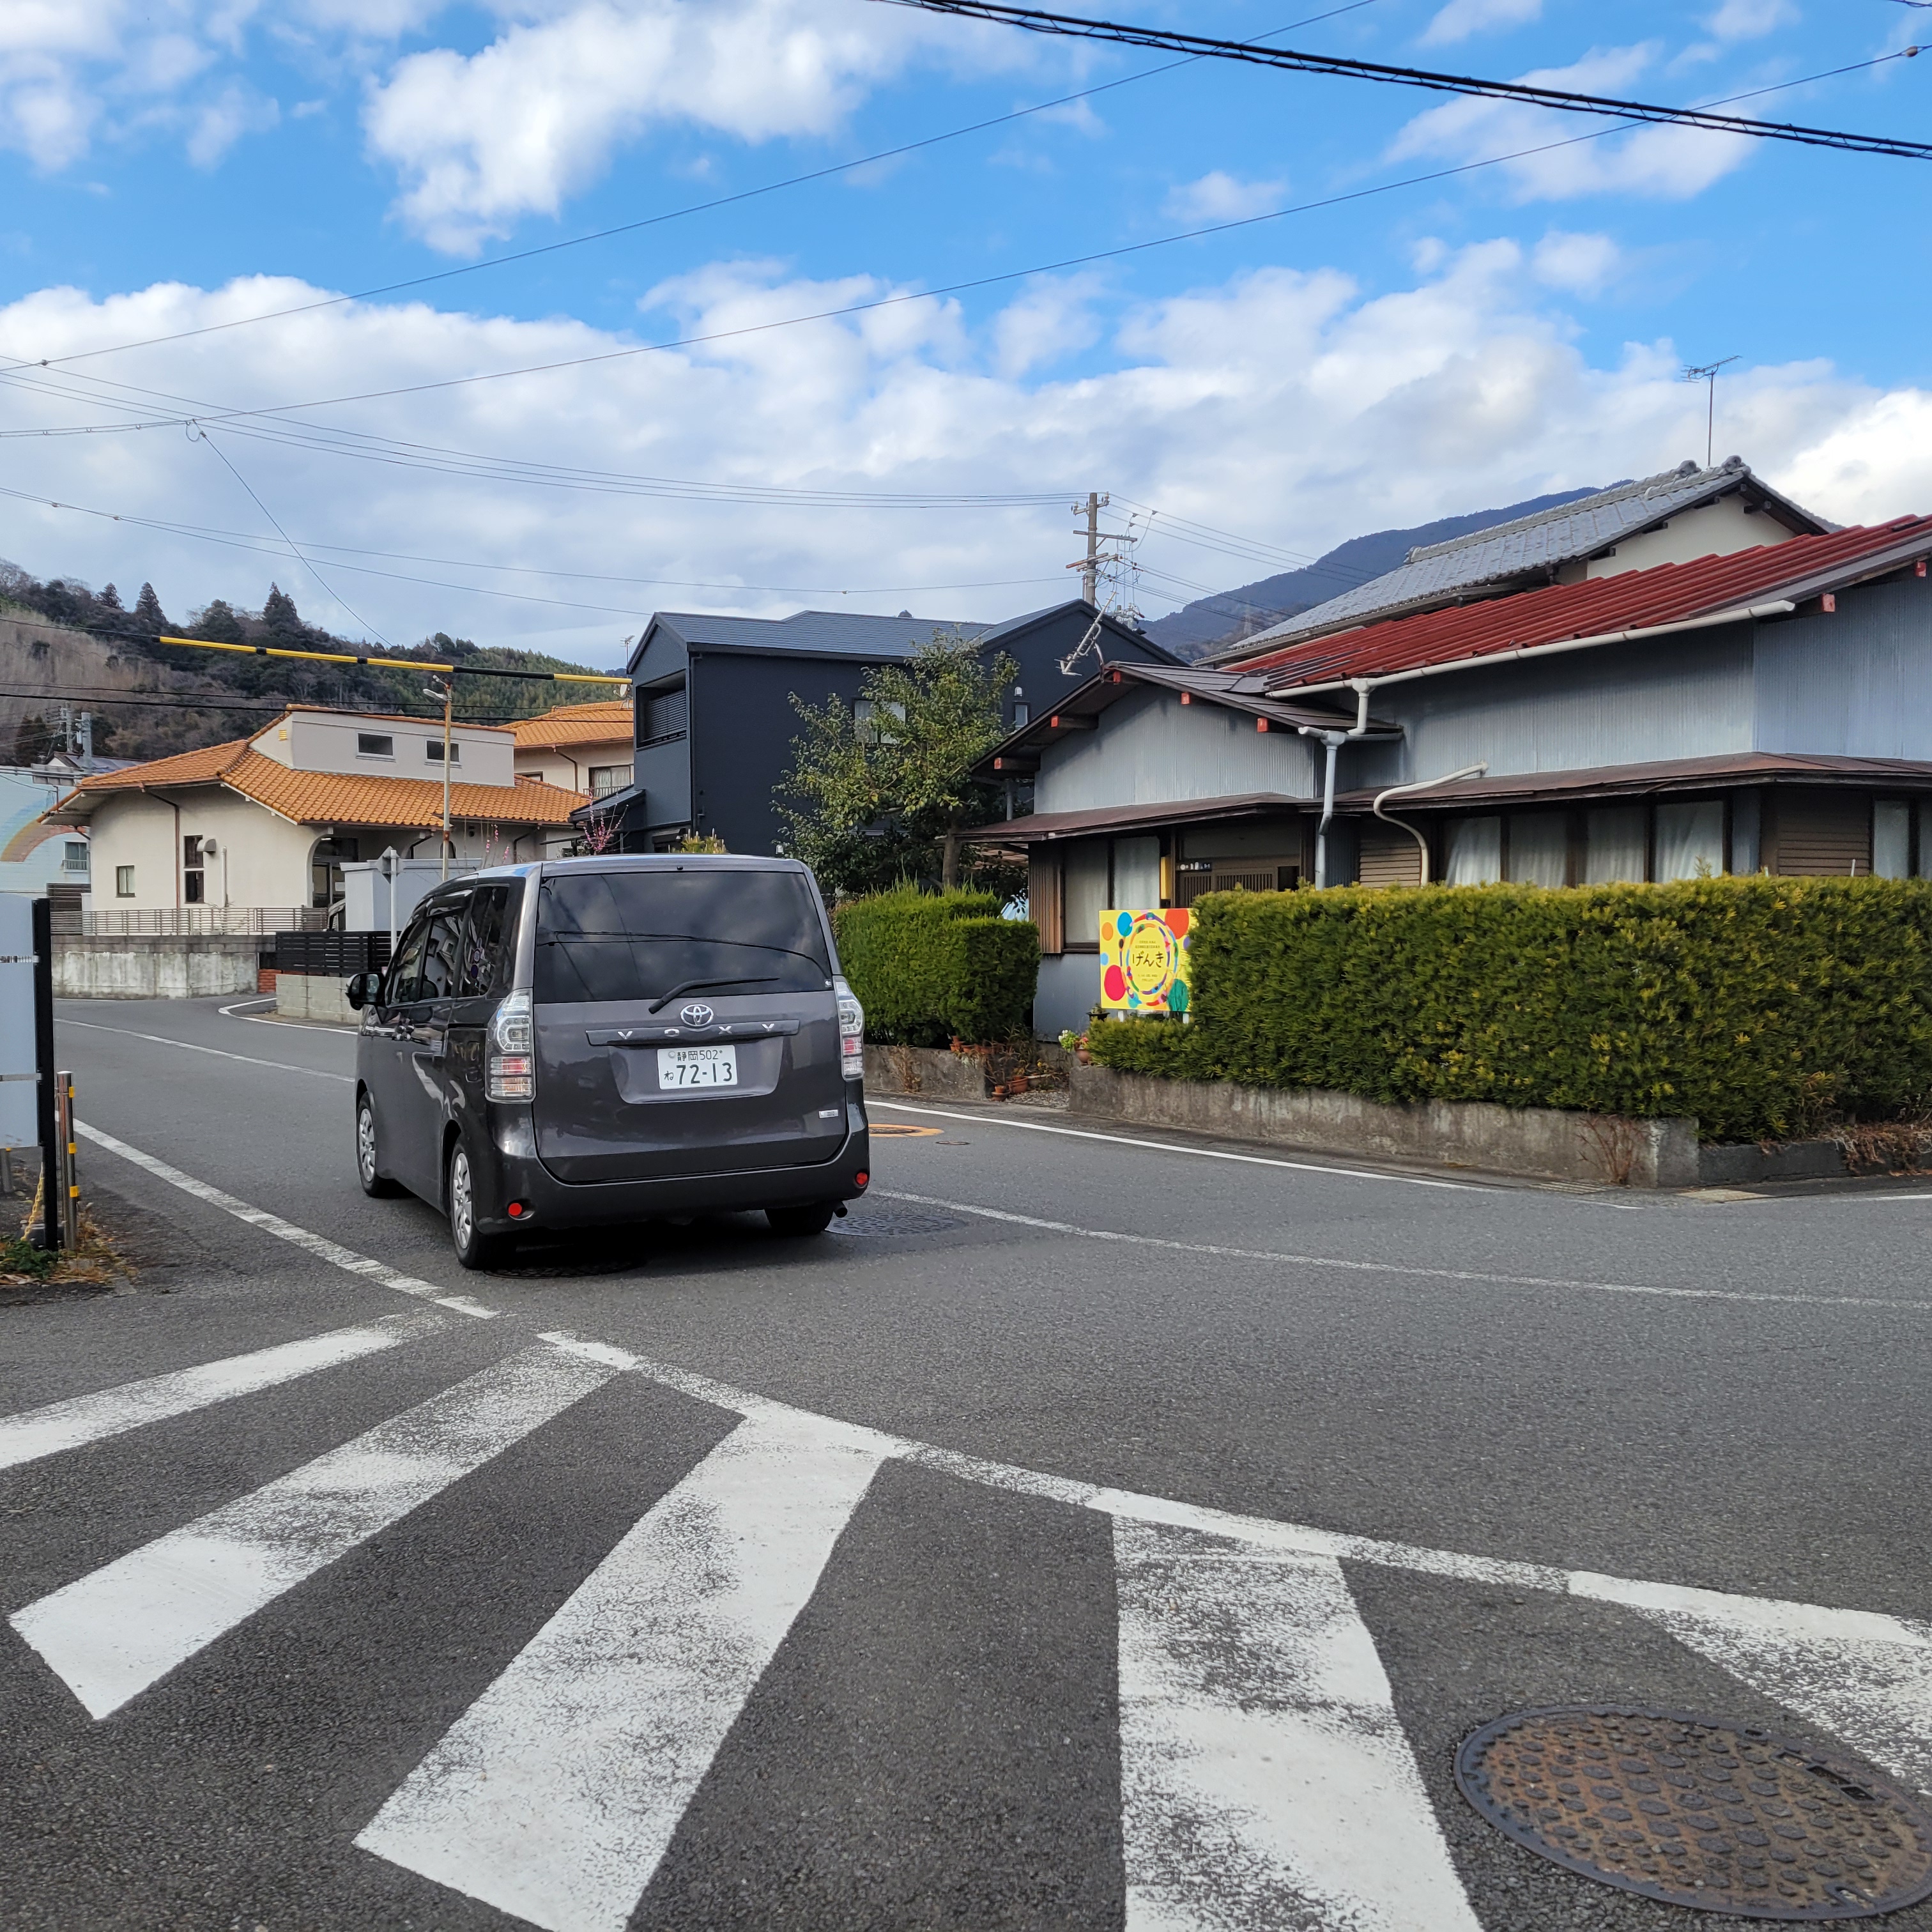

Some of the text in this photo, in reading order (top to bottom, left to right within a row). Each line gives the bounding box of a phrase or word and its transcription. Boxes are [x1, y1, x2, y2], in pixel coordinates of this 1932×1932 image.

[1133, 951, 1164, 968] げんき
[617, 1023, 775, 1040] VOXY
[664, 1062, 732, 1085] ね 72-13
